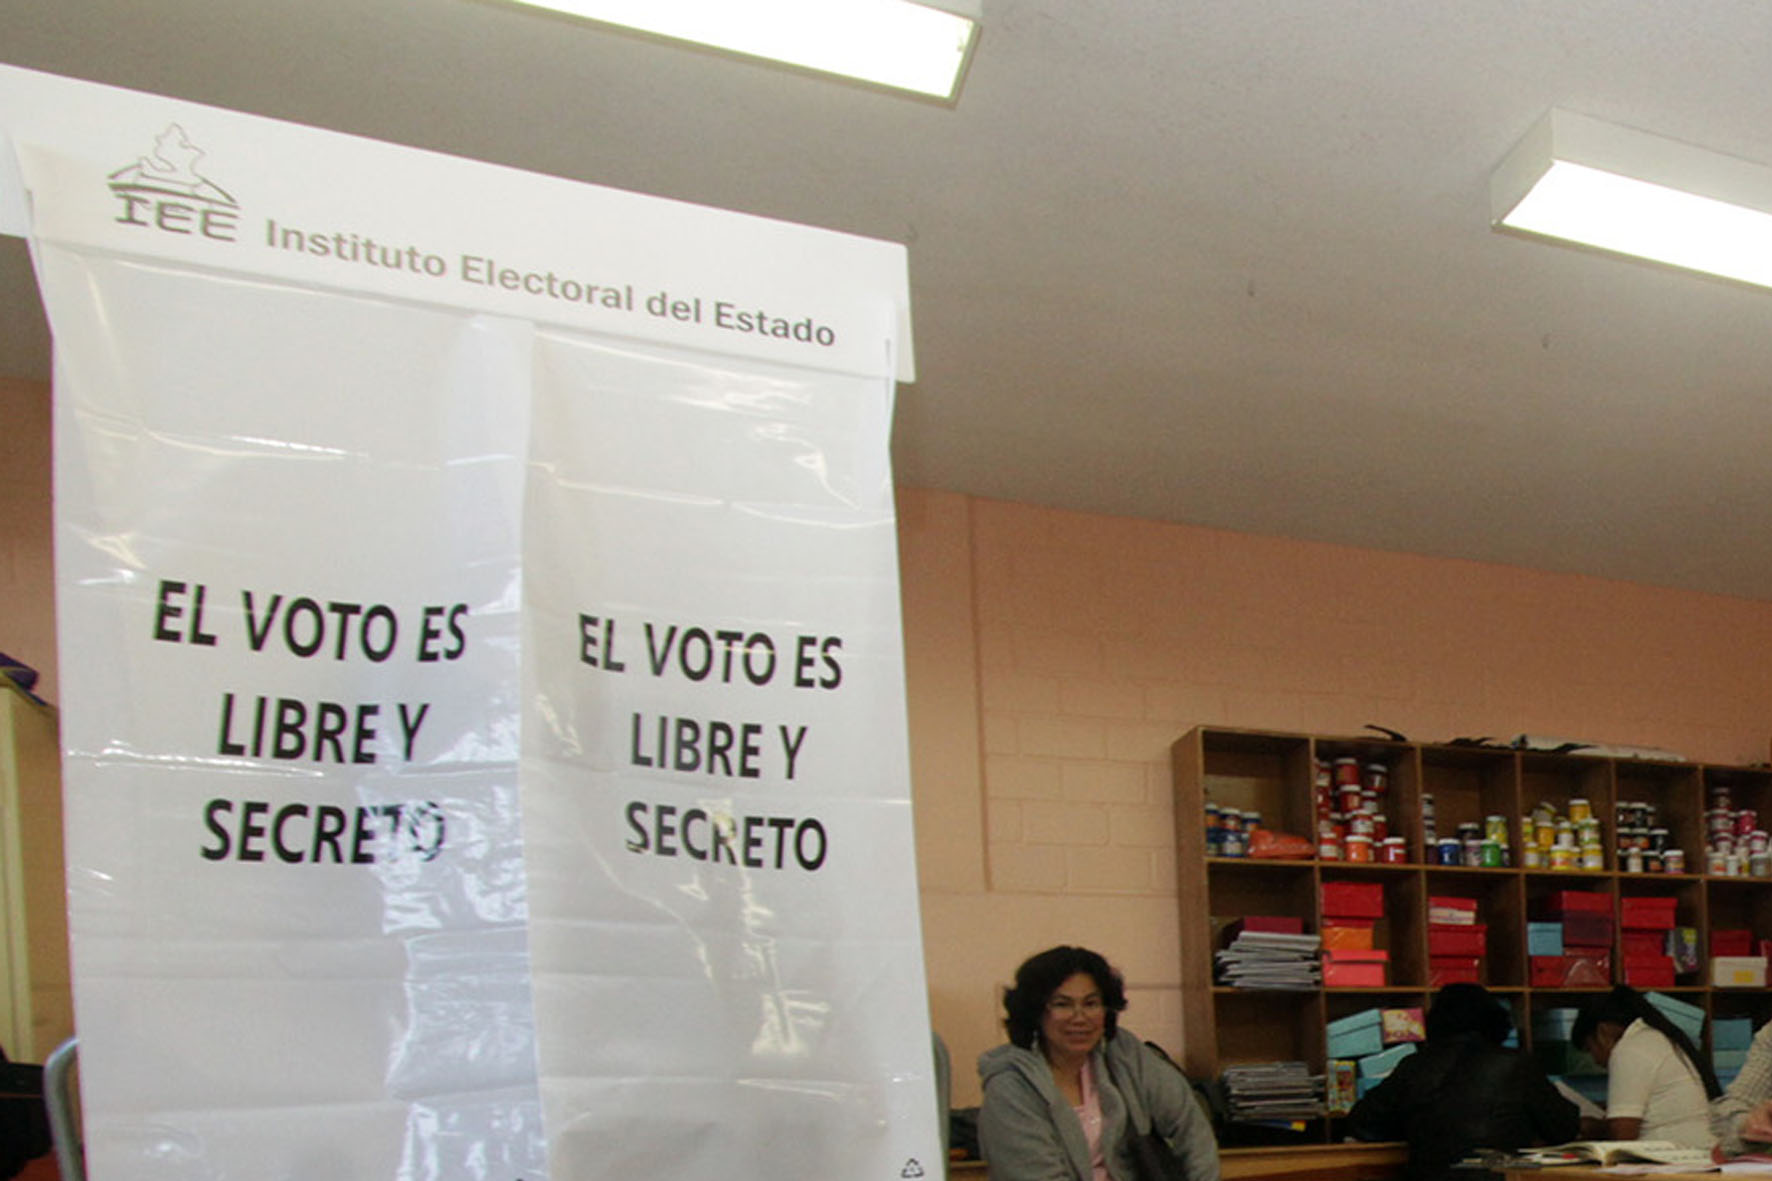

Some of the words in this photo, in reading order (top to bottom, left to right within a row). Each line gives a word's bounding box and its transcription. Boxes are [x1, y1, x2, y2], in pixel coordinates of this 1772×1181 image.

[112, 193, 240, 242] IEE
[265, 217, 447, 278] Instituto
[459, 253, 634, 312] Electoral
[645, 290, 702, 324] del
[713, 301, 836, 348] Estado
[152, 579, 219, 648] EL
[241, 589, 400, 663] VOTO
[417, 602, 470, 664] ES
[578, 612, 626, 673] EL
[644, 621, 777, 688] VOTO
[794, 634, 845, 690] ES
[217, 692, 381, 766] LIBRE
[396, 702, 430, 762] Y
[630, 711, 763, 780] LIBRE
[778, 724, 809, 781] Y
[625, 800, 828, 872] SECRETO
